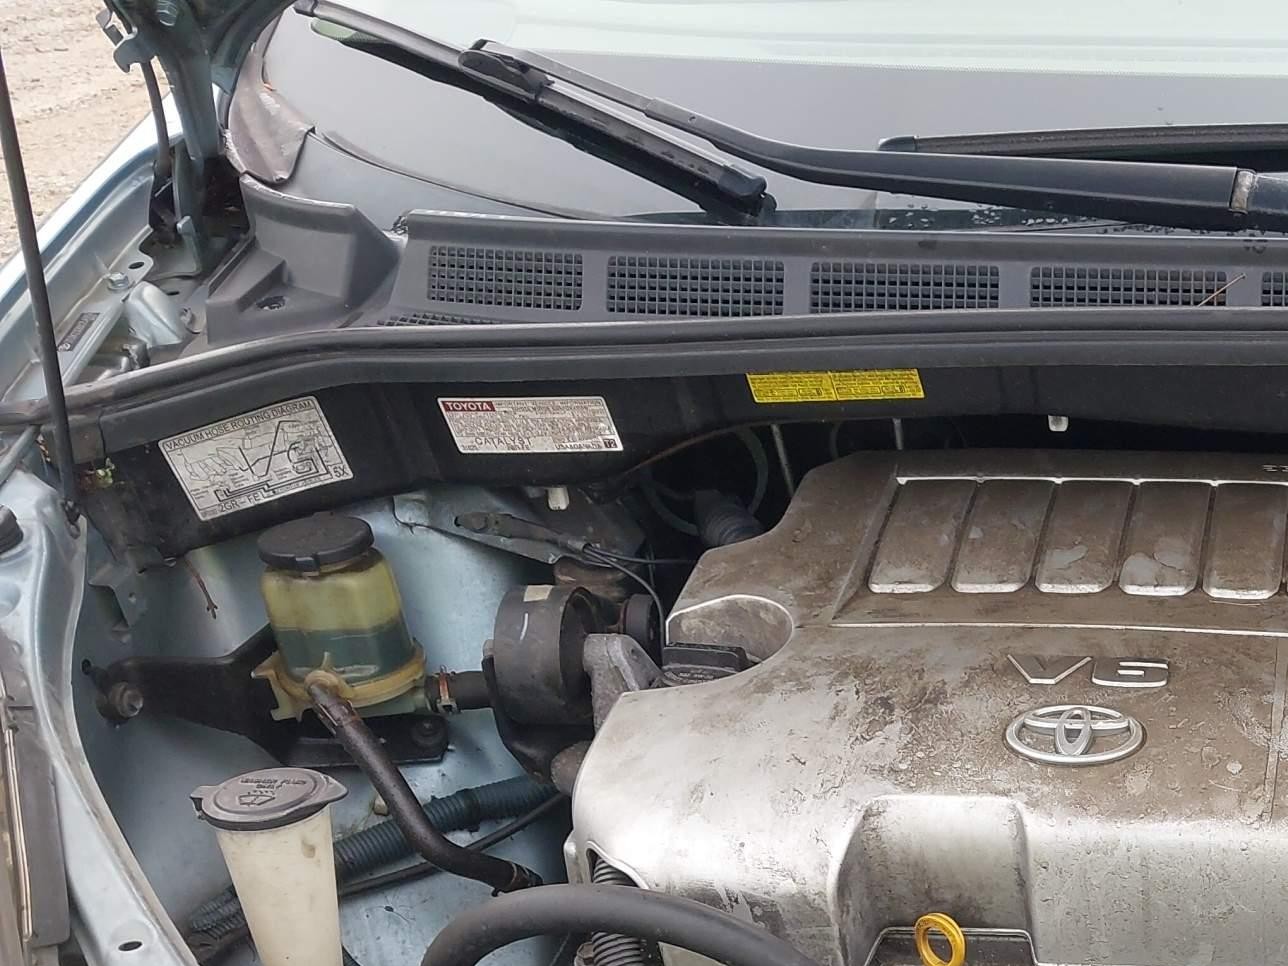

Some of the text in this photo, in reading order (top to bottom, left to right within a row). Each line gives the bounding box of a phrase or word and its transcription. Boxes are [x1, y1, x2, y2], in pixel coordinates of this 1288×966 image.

[445, 401, 491, 411] TOYOTA
[165, 432, 203, 450] VACUUM
[205, 424, 230, 439] HOSE
[230, 412, 271, 431] ROUTING
[272, 400, 313, 418] DIAGRAM
[474, 437, 532, 447] CATALYST
[604, 439, 617, 449] T2
[333, 465, 351, 478] 5X
[1006, 654, 1169, 688] V6
